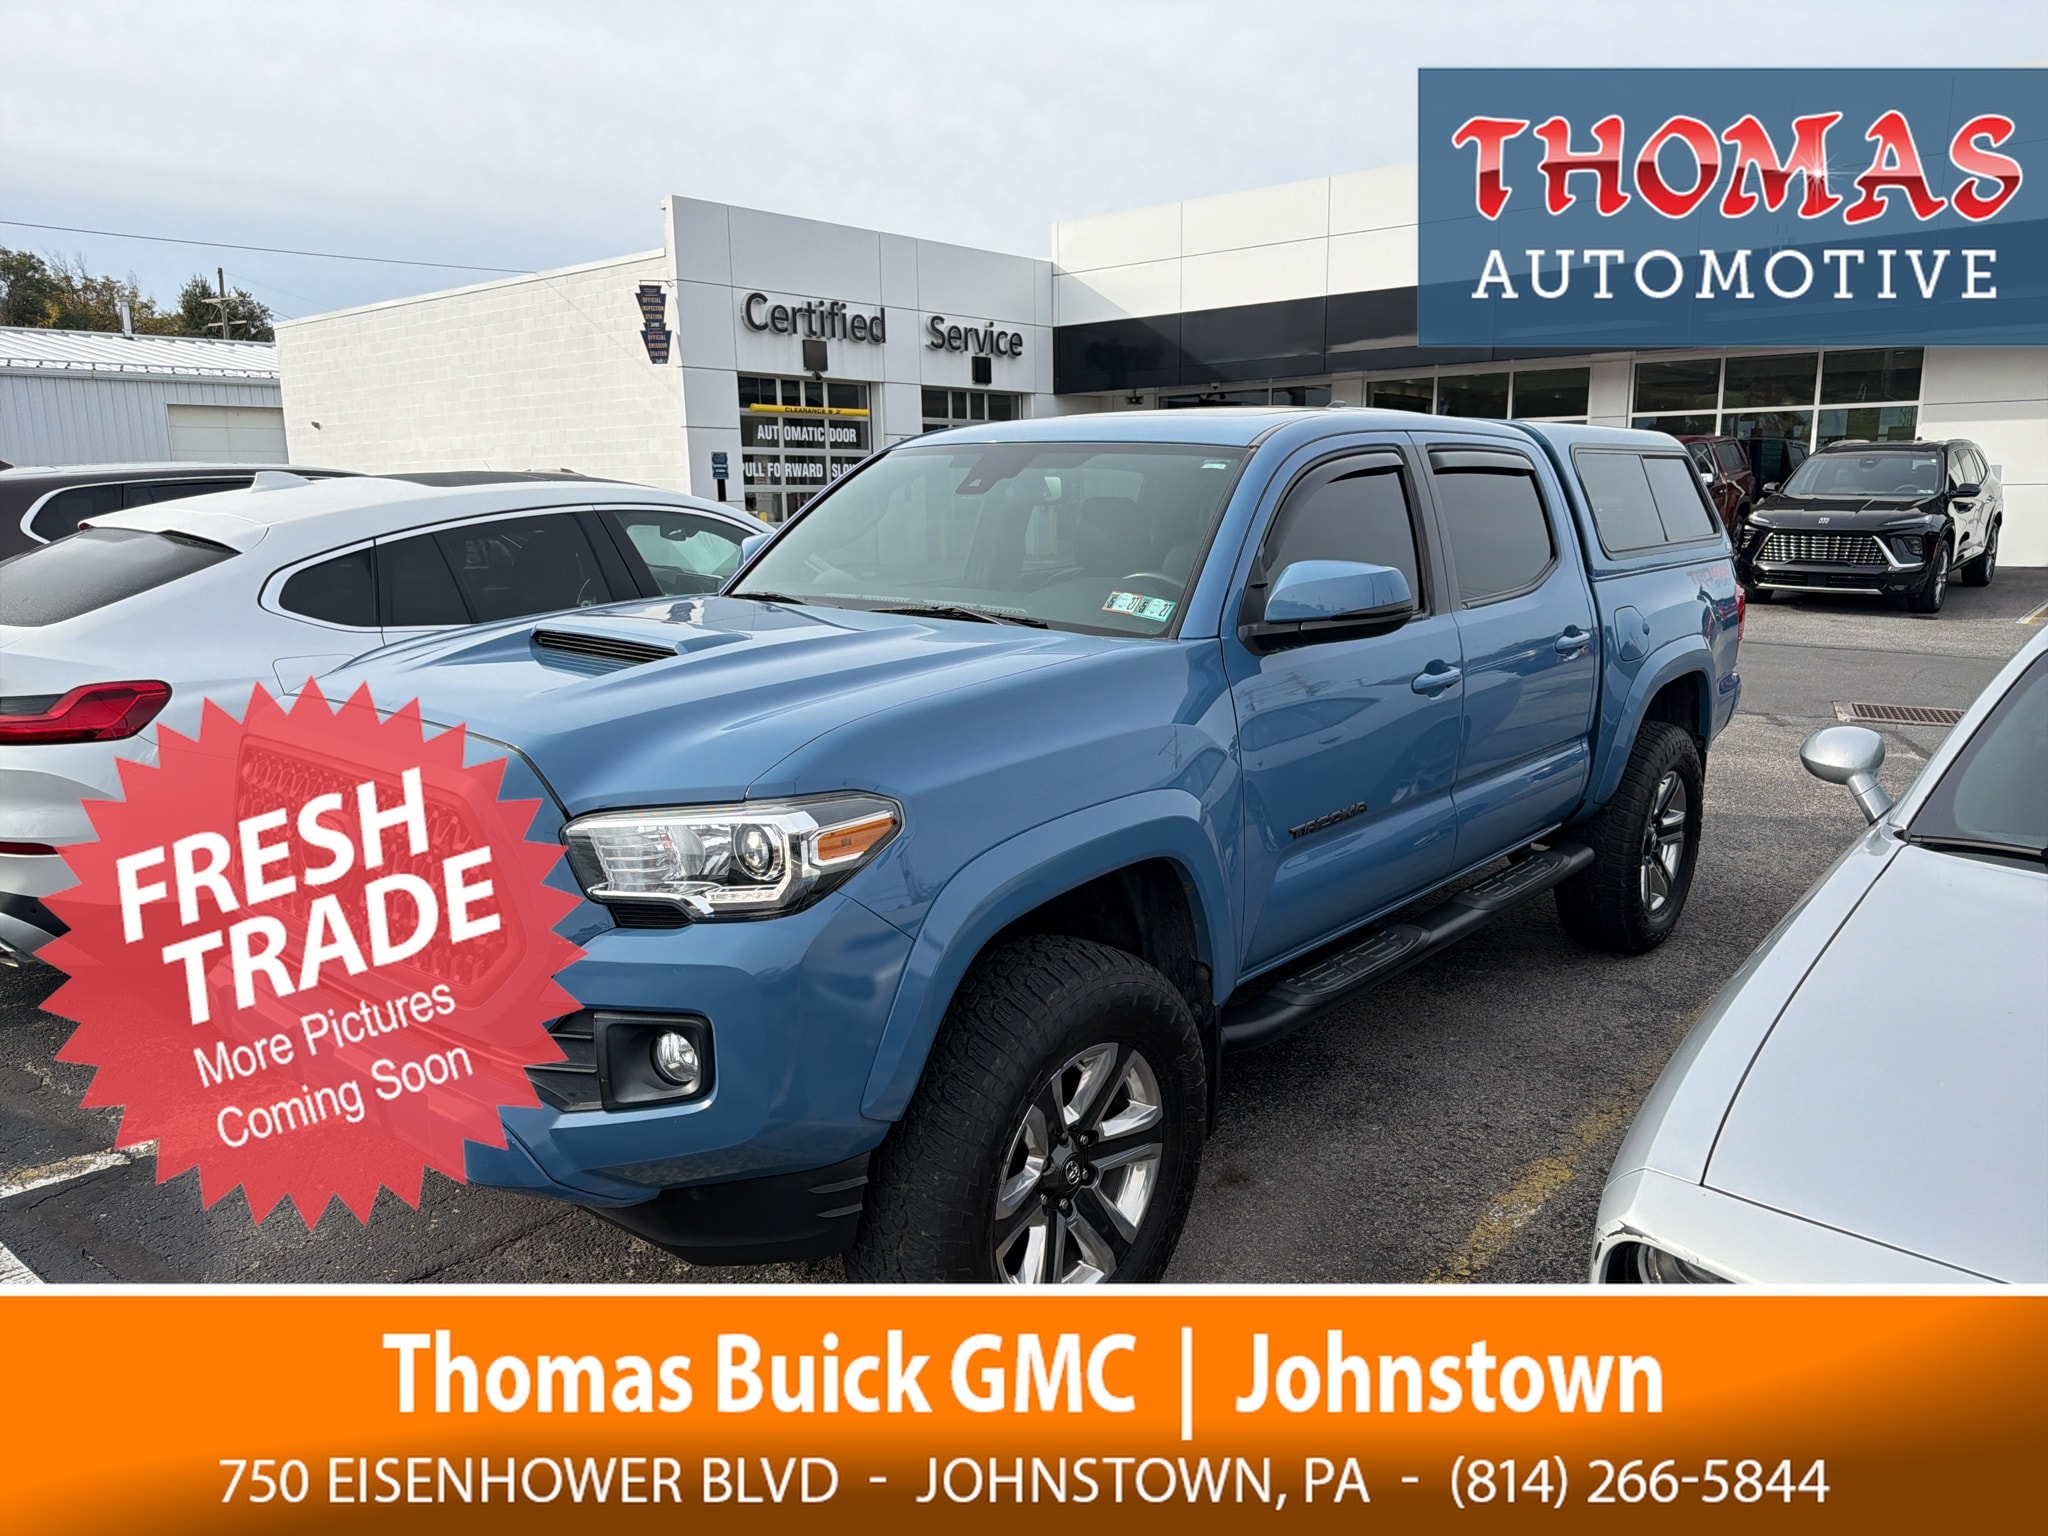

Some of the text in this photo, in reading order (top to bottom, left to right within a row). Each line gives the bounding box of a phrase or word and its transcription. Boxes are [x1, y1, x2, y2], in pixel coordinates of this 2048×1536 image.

[741, 292, 1023, 357] Certified Service
[785, 407, 826, 415] CLEARANCE
[757, 424, 857, 443] AUTOMATIC DOOR
[768, 462, 823, 478] FORWARD
[1288, 801, 1367, 839] TACOMA
